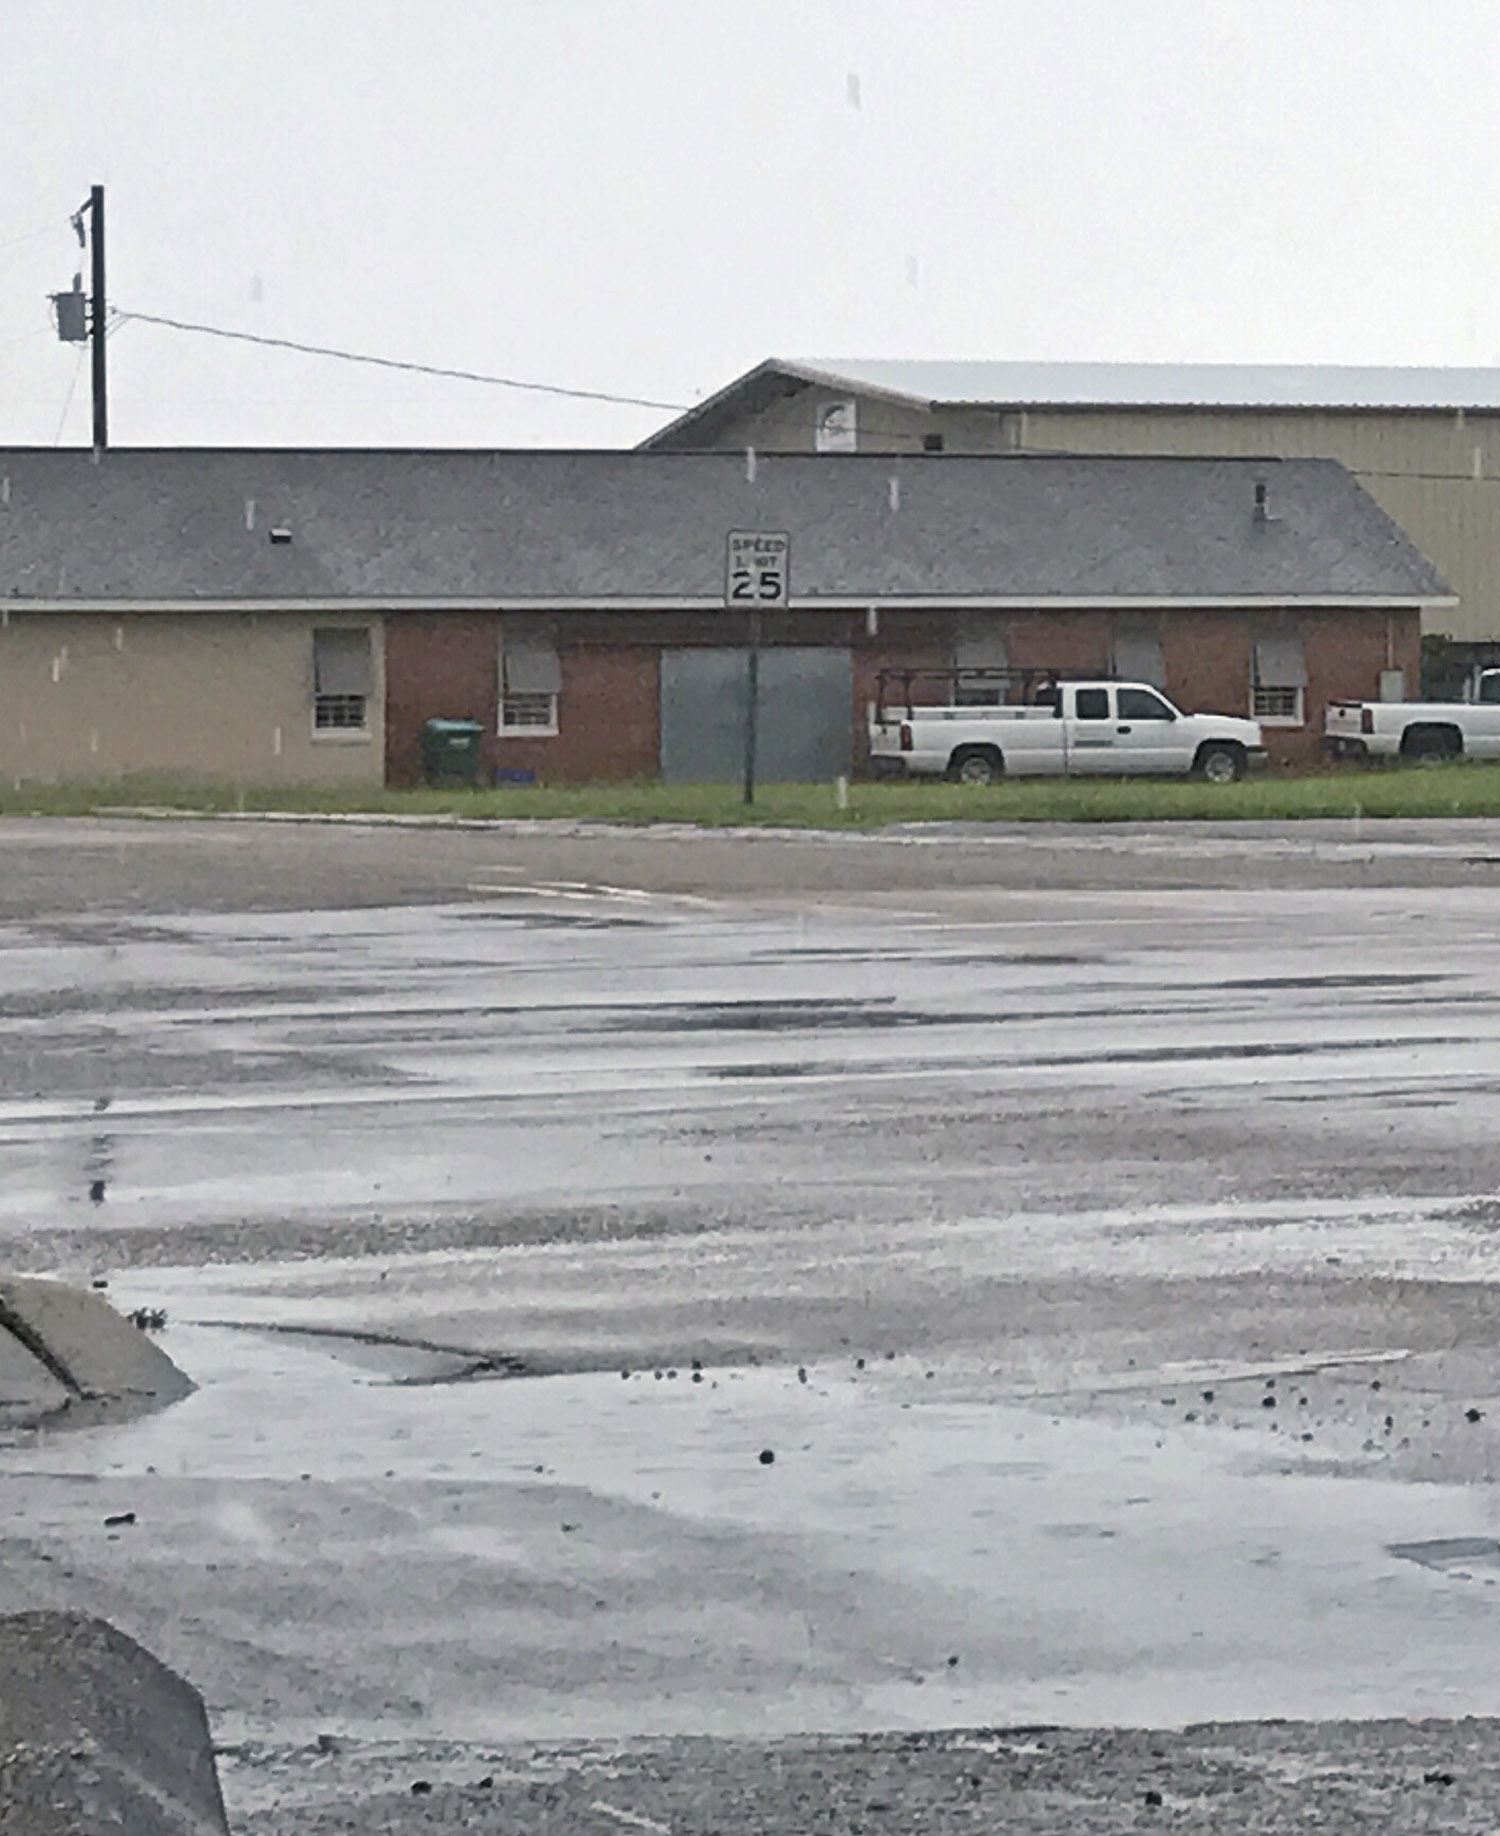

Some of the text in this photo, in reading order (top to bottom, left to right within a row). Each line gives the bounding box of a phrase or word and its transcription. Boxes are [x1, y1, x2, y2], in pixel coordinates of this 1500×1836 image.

[732, 538, 786, 552] SPEED
[735, 555, 777, 568] LIT
[732, 571, 781, 600] 25
